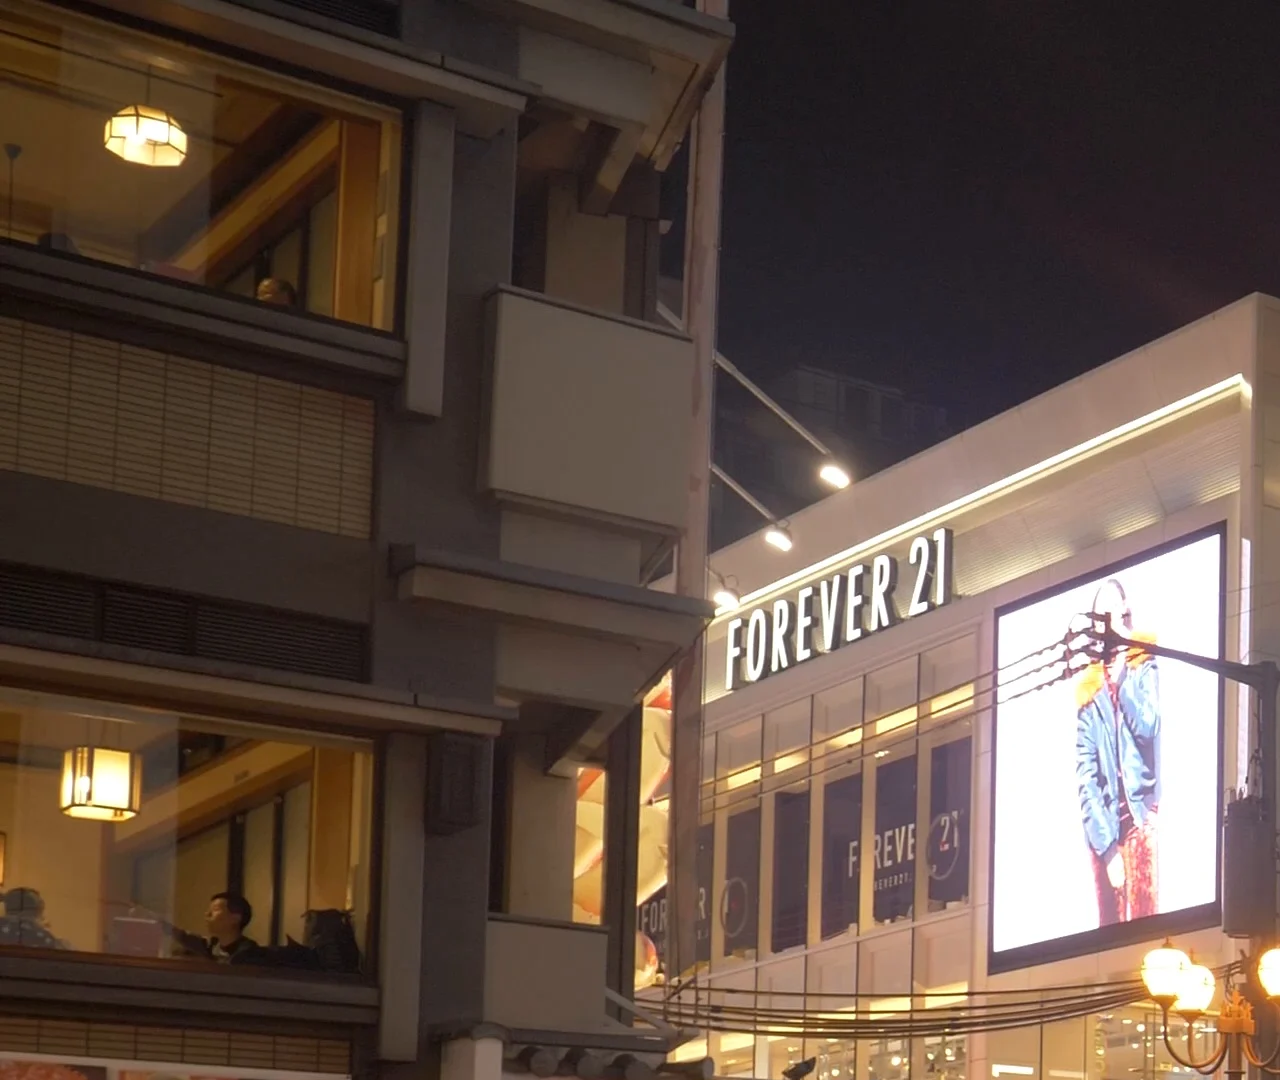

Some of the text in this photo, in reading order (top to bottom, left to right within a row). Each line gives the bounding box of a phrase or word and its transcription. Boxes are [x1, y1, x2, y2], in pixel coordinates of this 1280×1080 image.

[725, 527, 949, 692] FOREVER 21
[848, 822, 916, 879] FREVE
